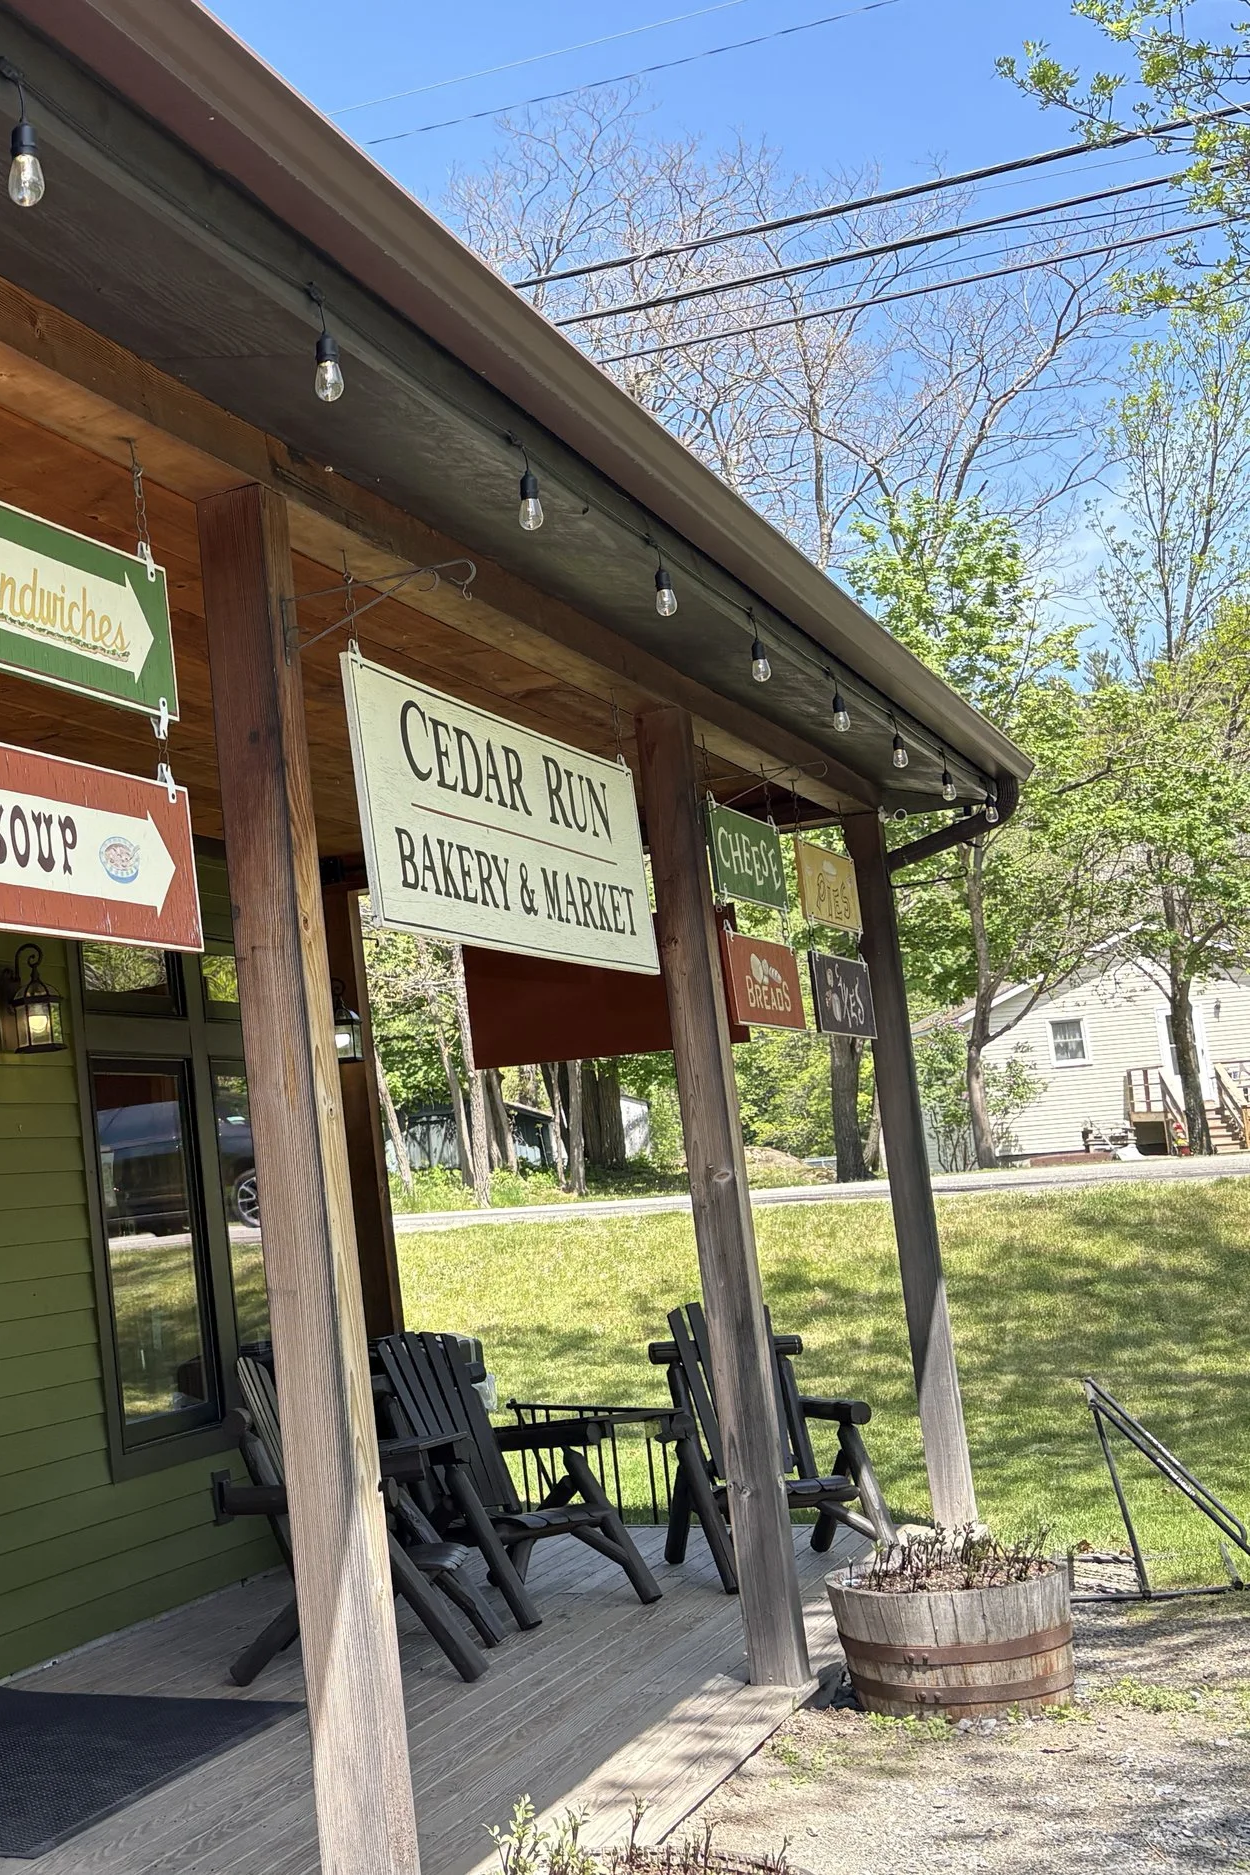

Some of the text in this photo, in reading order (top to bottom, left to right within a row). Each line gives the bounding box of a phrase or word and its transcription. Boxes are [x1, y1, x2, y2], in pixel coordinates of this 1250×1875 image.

[400, 700, 613, 844] CEDAR RUN
[395, 827, 637, 936] BAKERY & MARKET
[717, 827, 782, 891] CHEESE
[745, 974, 792, 1012] BREADS
